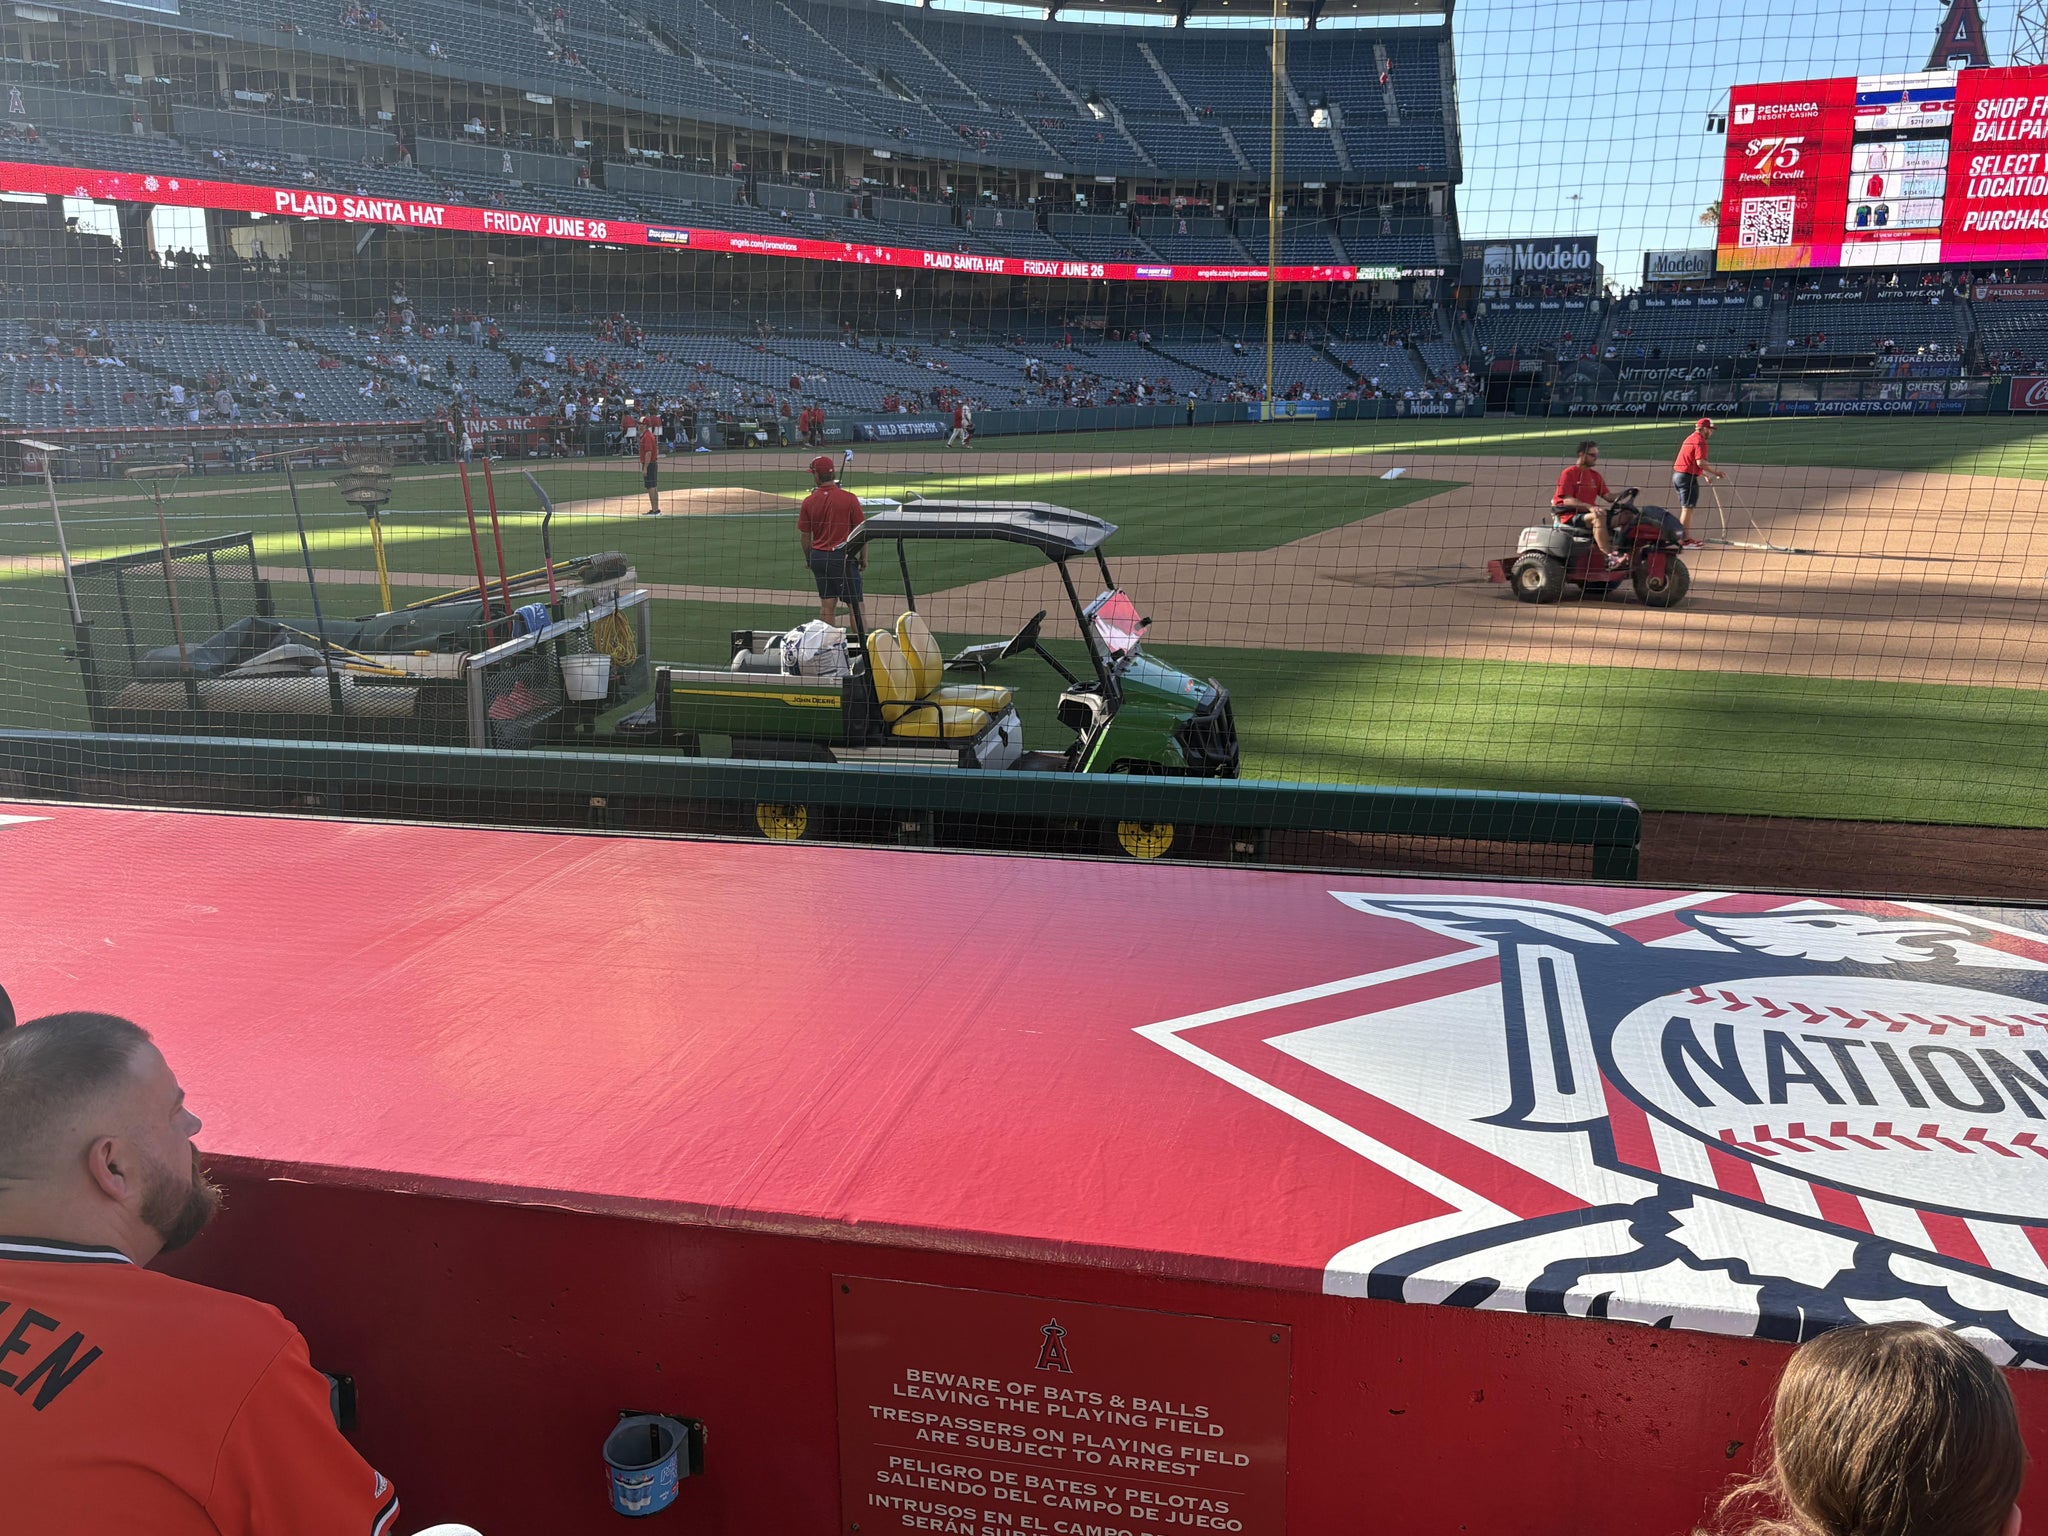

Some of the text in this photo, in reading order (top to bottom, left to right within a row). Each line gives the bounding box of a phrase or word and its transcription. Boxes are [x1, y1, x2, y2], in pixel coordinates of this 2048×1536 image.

[1757, 102, 1819, 115] PECHANGA
[1790, 111, 1819, 119] CASINO
[1974, 97, 2028, 120] SHOP
[1745, 136, 1805, 170] $75
[1968, 153, 2040, 177] SELECT
[1738, 169, 1805, 182] Resort Credit
[275, 191, 606, 239] PLAID SANTA HAT FRIDAY JUNE 26
[730, 238, 798, 251] angels.com/promotions
[1514, 244, 1591, 270] Modelo
[1657, 255, 1704, 272] Modelo
[924, 253, 1104, 277] PLAID SANTA HAT FRIDAY JUNE 26
[1198, 269, 1267, 279] angels.com/promotions
[1724, 296, 1745, 304] Modelo
[1796, 291, 1862, 300] NITTO TIRE.COM
[1877, 289, 1945, 298] NITTO TIRE.COM
[1491, 302, 1510, 310] Modelo
[1515, 302, 1535, 310] Modelo
[1541, 301, 1560, 309] Modelo
[1565, 300, 1585, 308] Modelo
[1645, 299, 1666, 307] Modelo
[1671, 298, 1692, 306] Modelo
[1697, 297, 1718, 306] Modelo
[1878, 354, 1961, 363] 714TICKETS.COM
[1410, 402, 1449, 414] Modelo
[1568, 403, 1647, 412] NITTO TIRE.COM
[1658, 402, 1738, 412] NITTO TIRE.COM
[1814, 401, 1912, 411] 714TICKETS.COM
[506, 418, 535, 430] INC.
[877, 422, 938, 436] MLB NETWORK
[1035, 1318, 1073, 1374] A
[0, 1301, 104, 1412] EN
[907, 1369, 1209, 1419] BEWARE OF BATS & BALLS
[894, 1384, 1224, 1437] LEAVING THE PLAYING FIELD
[869, 1406, 1250, 1467] TRESPASSERS ON PLAYING FIELD
[916, 1428, 1200, 1477] ARE SUBJECT TO ARREST
[890, 1456, 1229, 1513] PELIGRO DE BATES Y PELOTAS
[877, 1471, 1242, 1531] SALIENDO DEL CAMPO DE JUEGO
[868, 1494, 1132, 1536] INTRUSOS EN EL CAMPO
[902, 1515, 974, 1536] SERÁN
